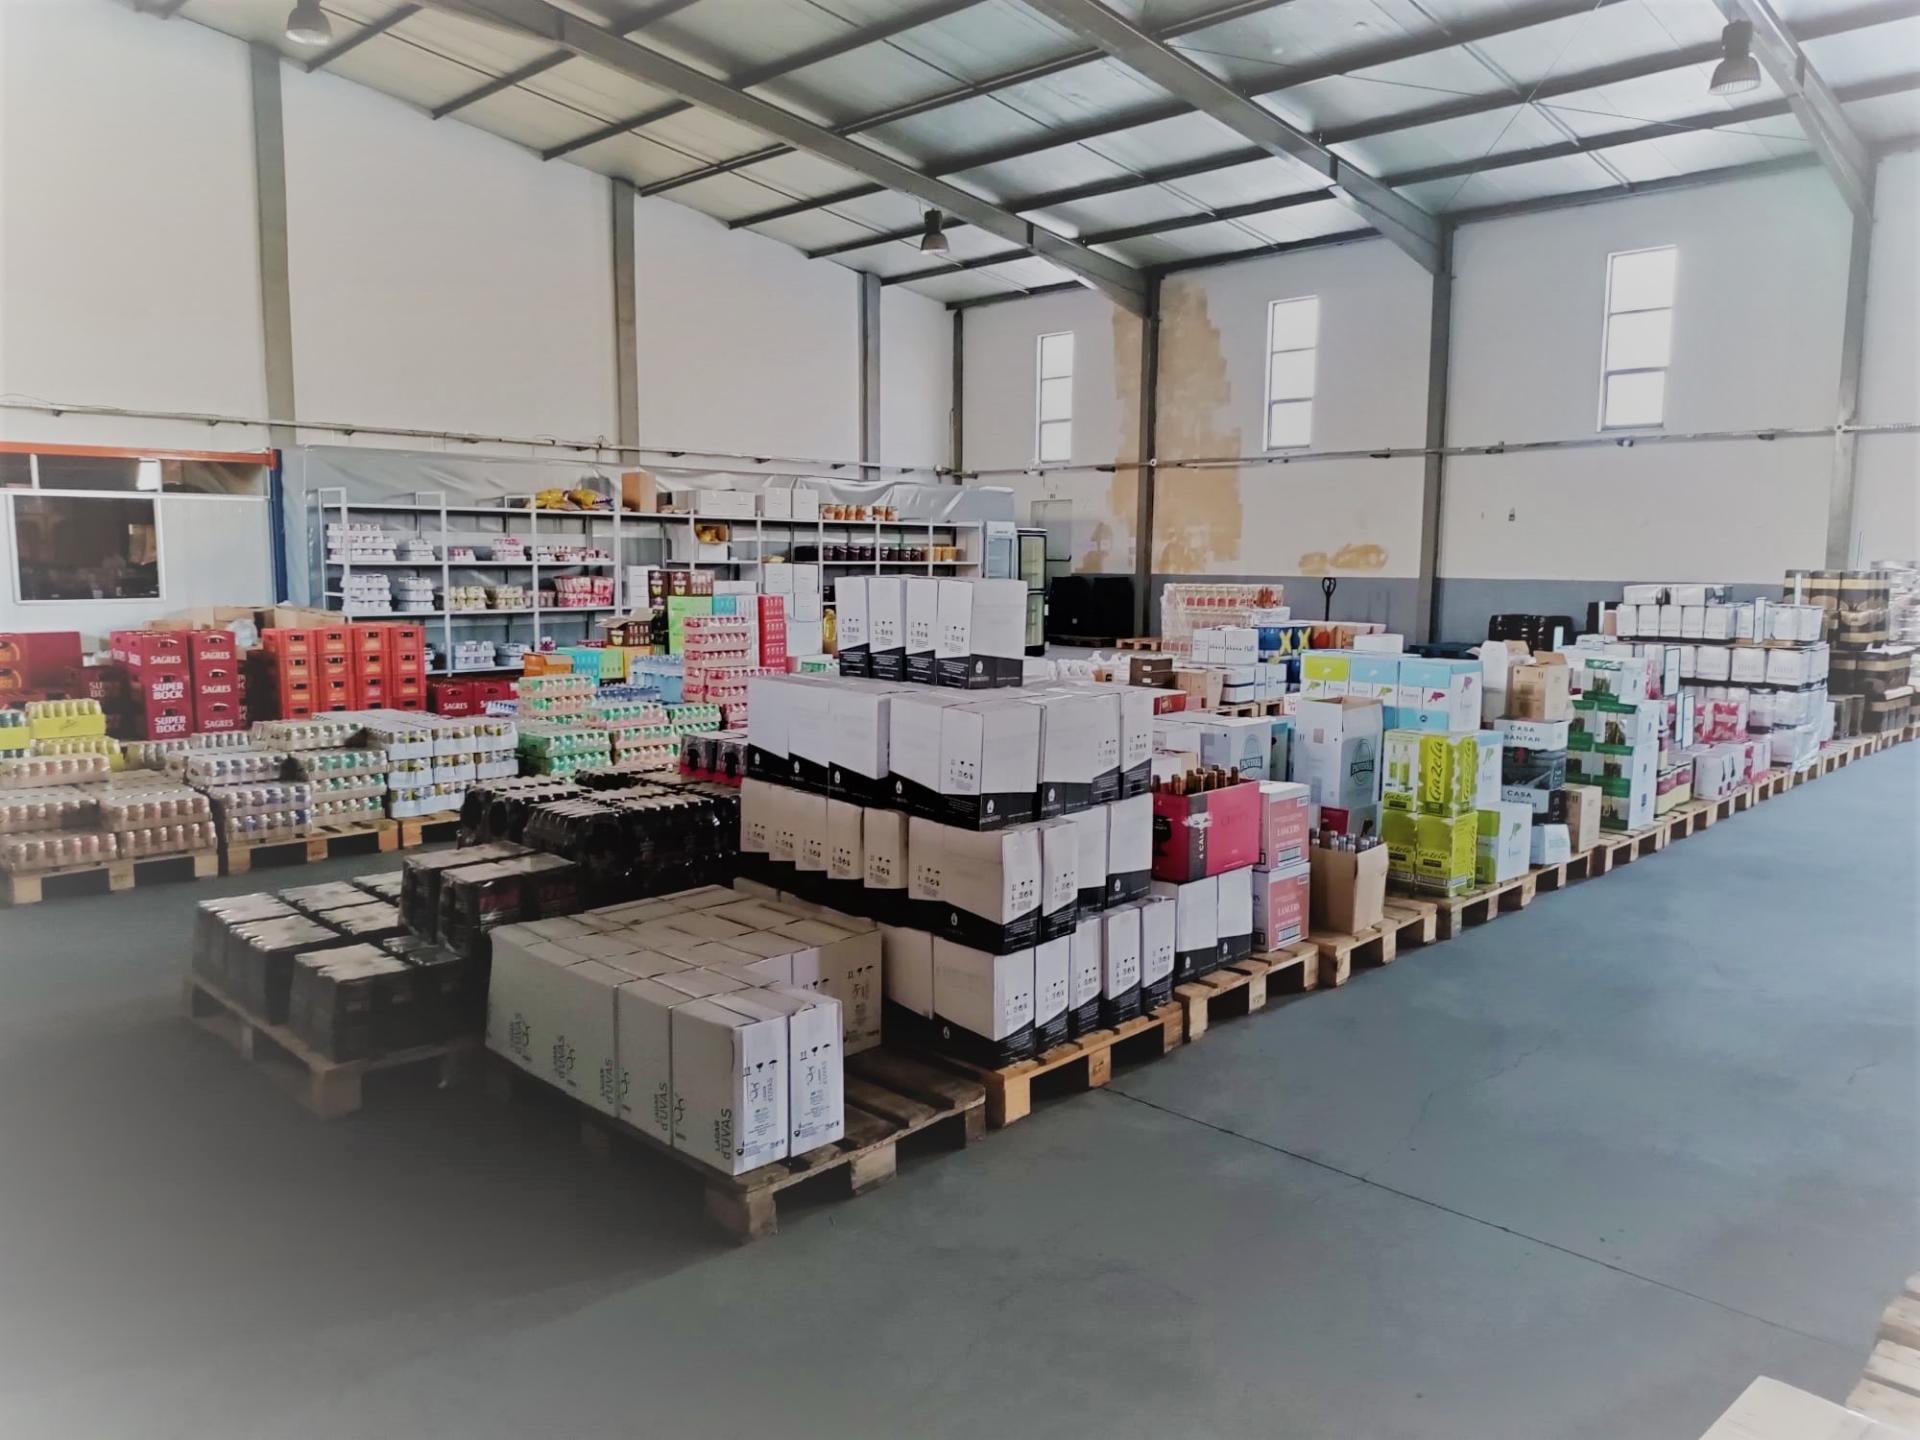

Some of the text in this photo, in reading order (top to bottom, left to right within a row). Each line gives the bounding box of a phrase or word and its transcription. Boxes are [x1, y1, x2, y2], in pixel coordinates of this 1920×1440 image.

[150, 655, 182, 665] SAGRES
[200, 651, 230, 660] SAGRES
[152, 682, 184, 692] SUPER
[201, 685, 231, 694] SAGRES
[152, 690, 184, 700] BOCK
[443, 702, 468, 710] SAGRES
[154, 716, 186, 726] SUPER
[204, 719, 234, 728] SAGRES
[156, 724, 186, 733] BOCK
[1507, 790, 1532, 798] CASA
